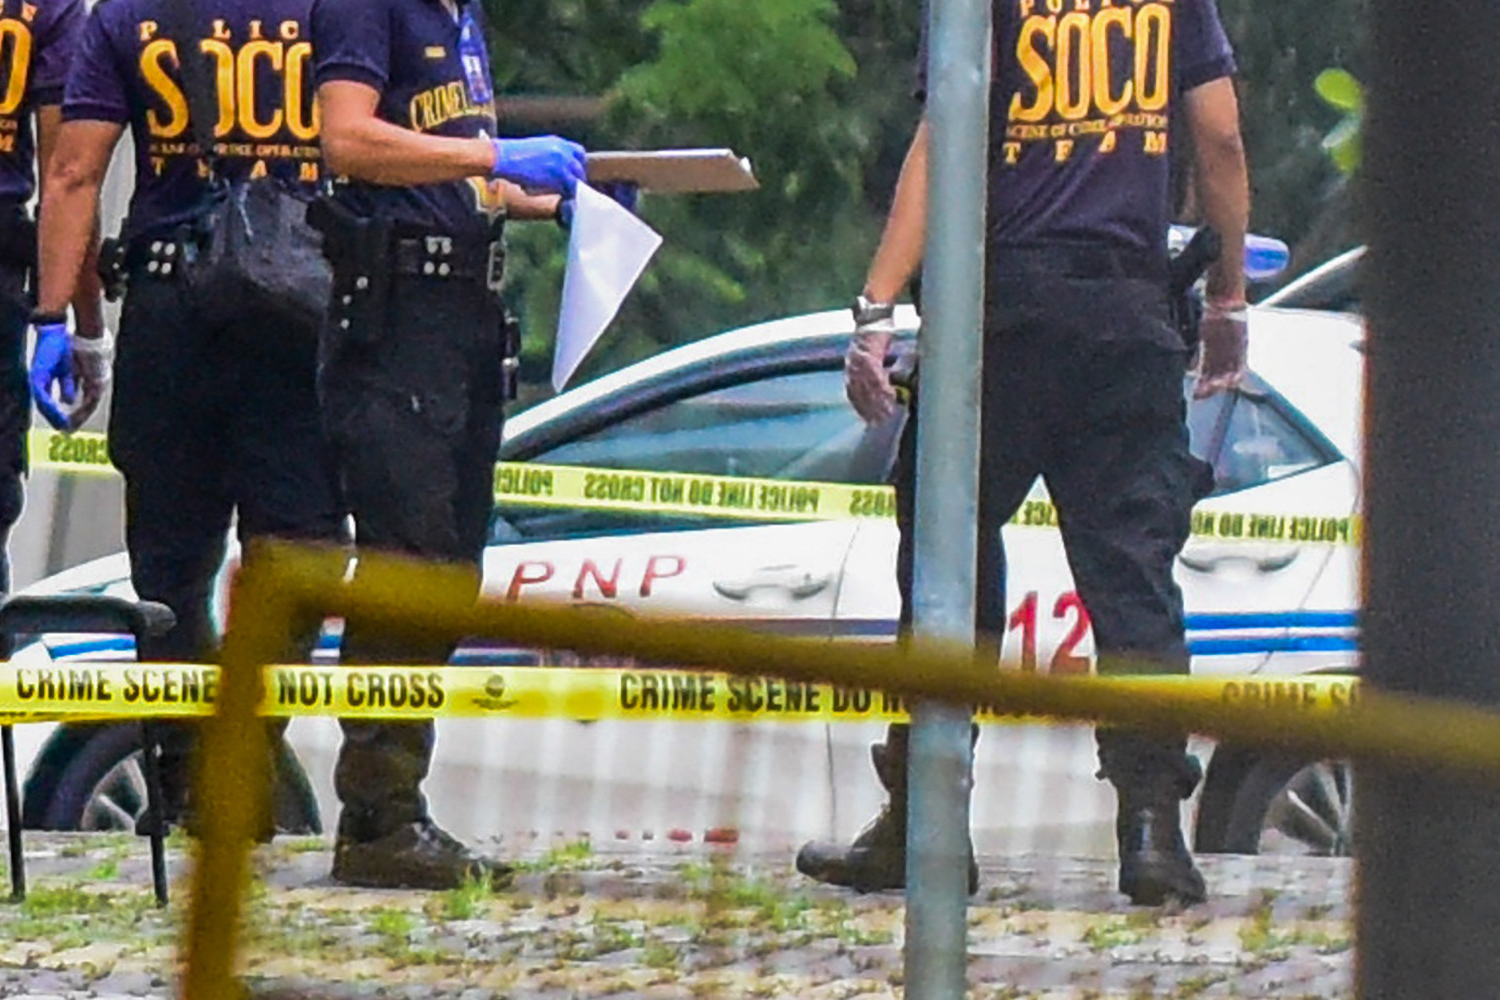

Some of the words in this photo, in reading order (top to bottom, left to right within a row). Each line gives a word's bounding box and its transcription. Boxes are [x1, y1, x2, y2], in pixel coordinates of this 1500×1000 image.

[139, 19, 300, 40] PLIC
[1008, 2, 1171, 122] SOCO
[506, 555, 687, 602] PNP
[1008, 590, 1091, 676] 12
[16, 668, 112, 702] CRIME
[122, 672, 216, 704] SCENE
[279, 671, 333, 706] NOT
[346, 672, 445, 709] CROSS
[620, 674, 715, 711] CRIME
[727, 677, 821, 713] SCENE
